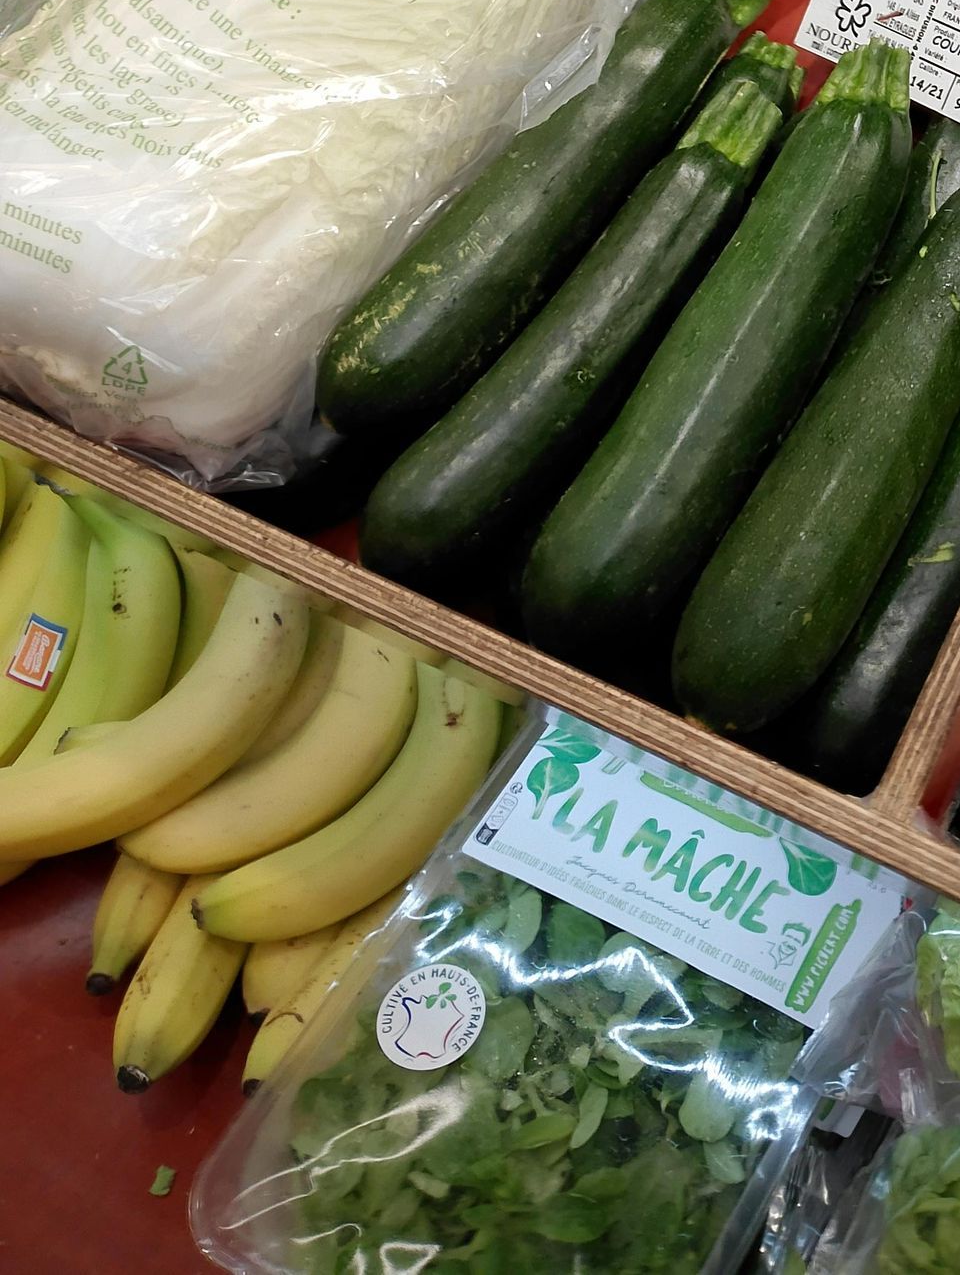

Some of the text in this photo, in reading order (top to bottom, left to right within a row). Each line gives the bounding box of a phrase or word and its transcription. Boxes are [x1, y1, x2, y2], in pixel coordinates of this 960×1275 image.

[209, 9, 243, 42] une
[916, 4, 937, 44] DIFFUSION
[83, 34, 111, 66] les
[125, 34, 150, 59] en
[151, 50, 199, 90] fines
[60, 72, 111, 111] petits
[909, 75, 945, 101] 14/21
[3, 201, 83, 245] minutes
[101, 376, 148, 396] LDPE
[551, 787, 619, 854] LA
[621, 817, 791, 934] MÂCHE
[490, 840, 539, 869] CULTIVATEUR
[605, 894, 630, 912] DANS
[628, 906, 640, 918] LE
[640, 907, 674, 935] RESPECT
[672, 926, 685, 941] DE
[684, 932, 697, 946] LA
[697, 939, 721, 960] TERRE
[721, 949, 733, 964] ET
[733, 957, 749, 975] DES
[750, 963, 788, 993] HOMMES
[410, 971, 426, 986] EN
